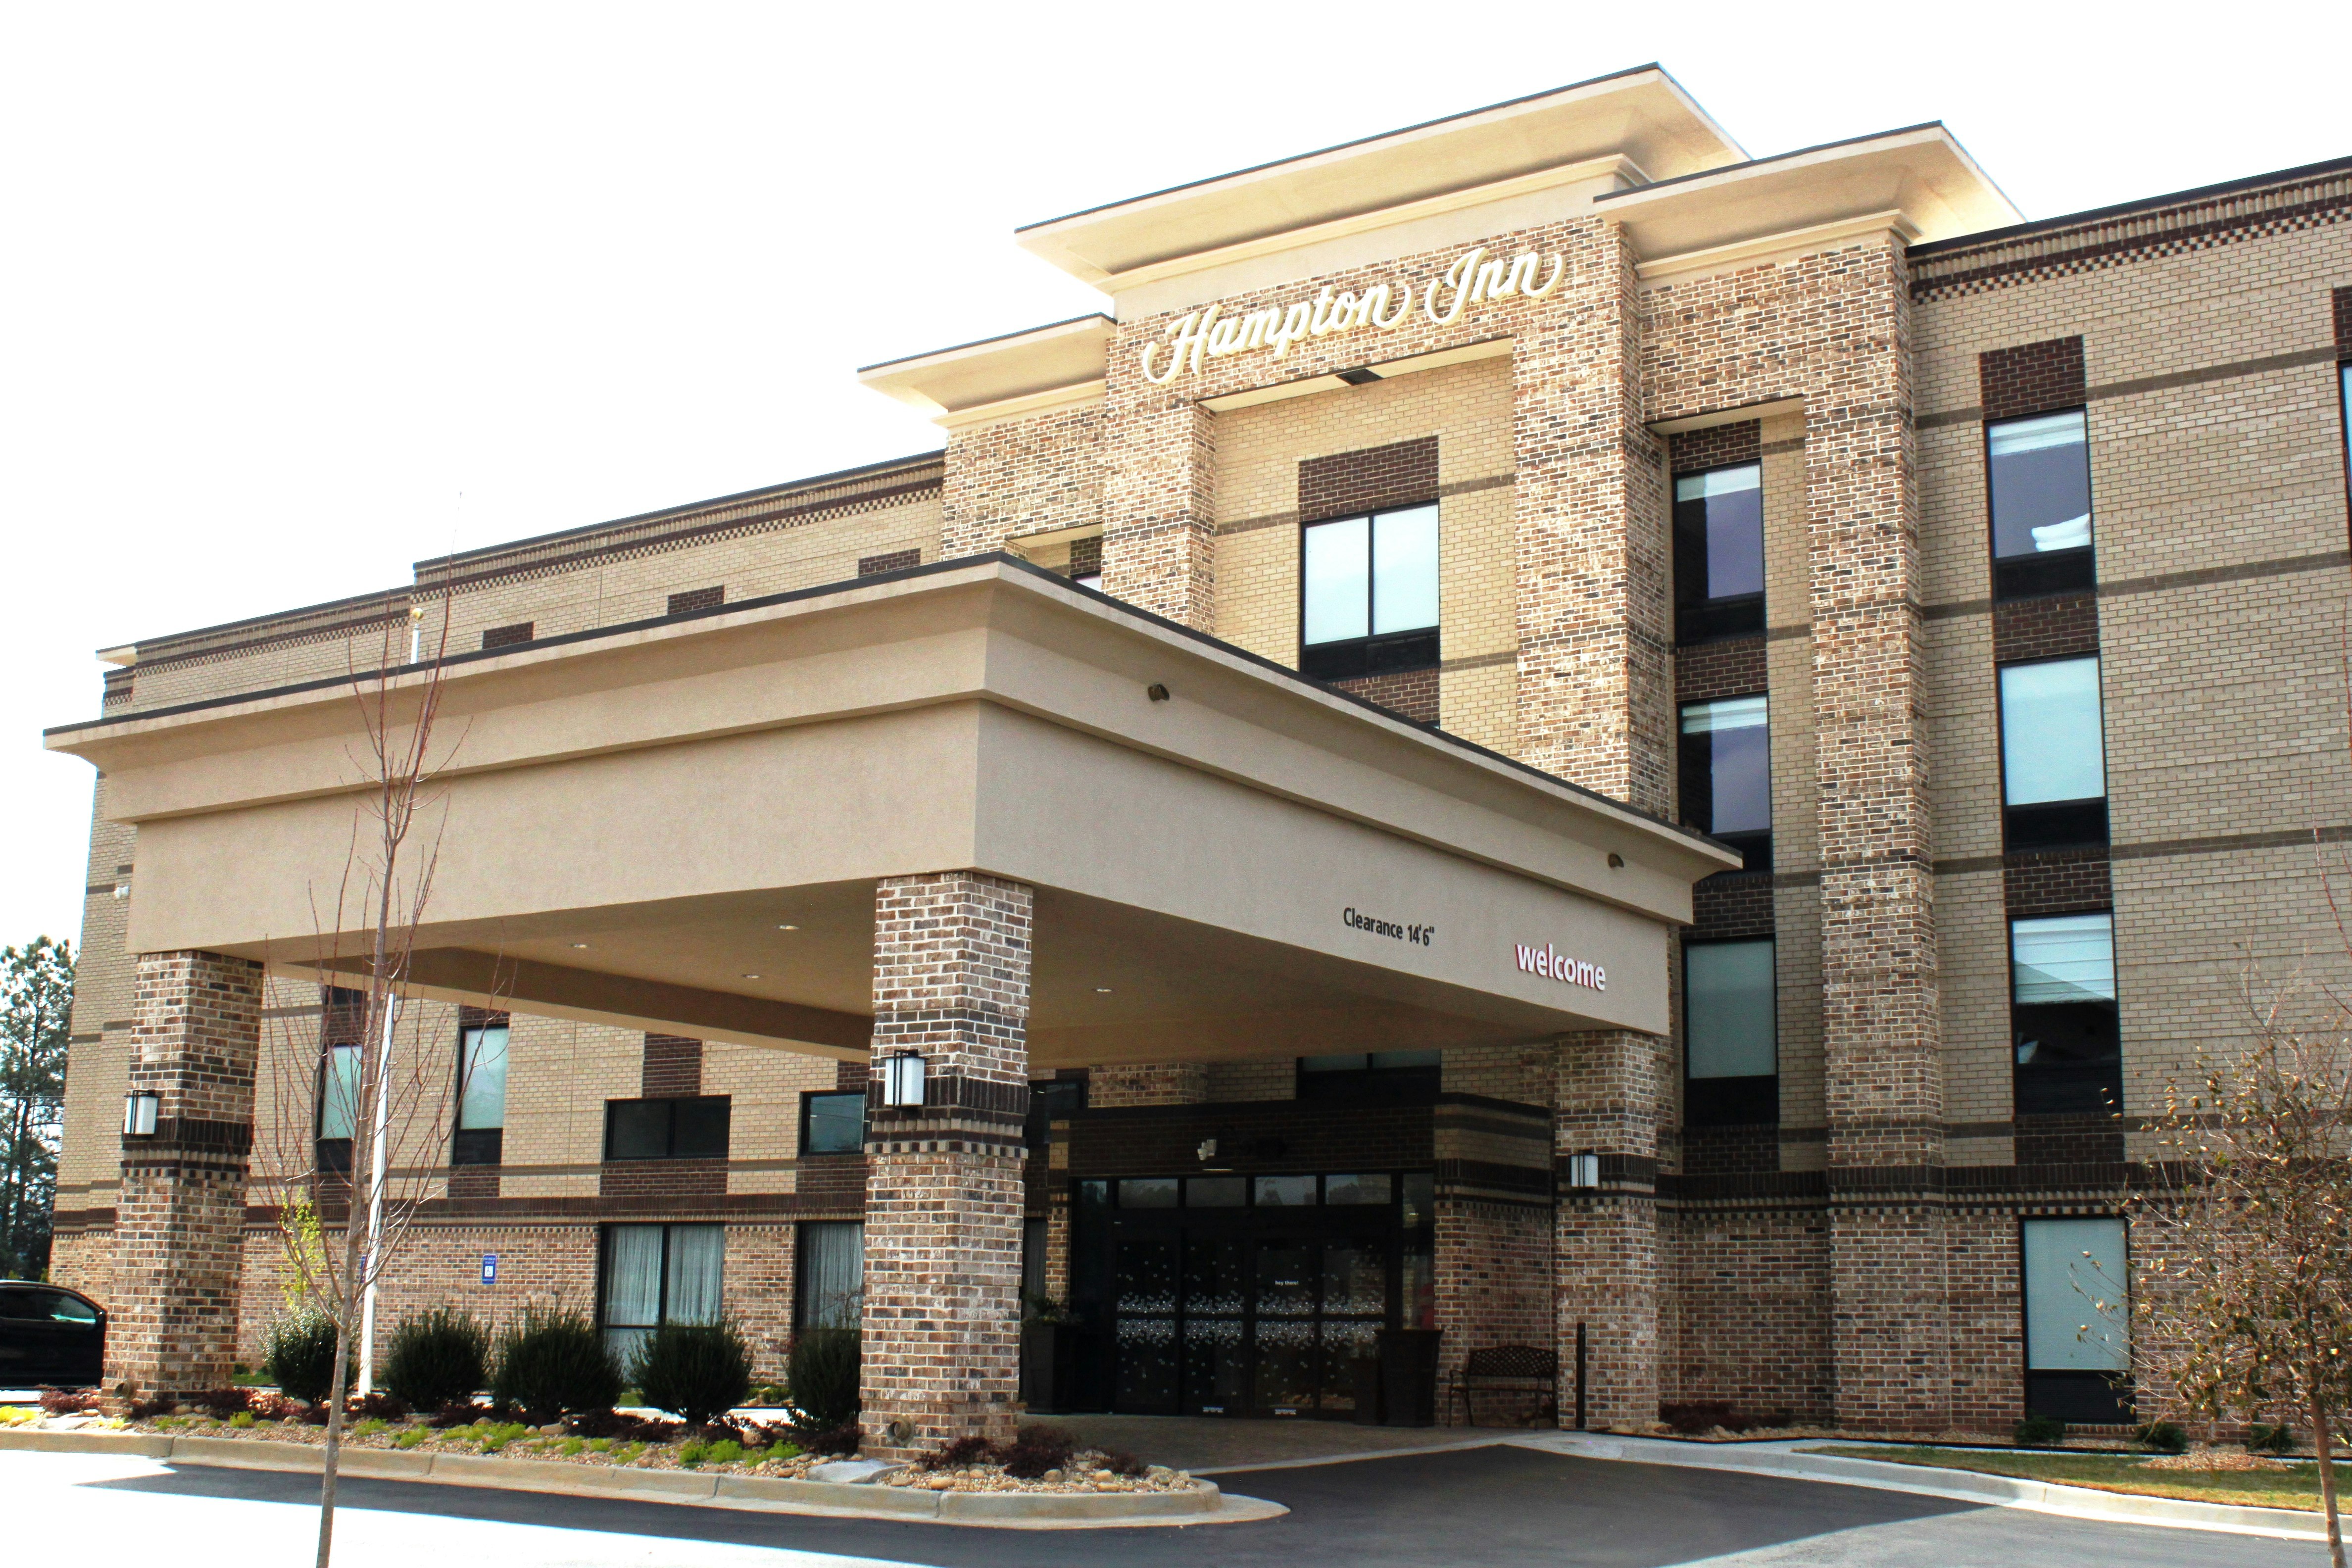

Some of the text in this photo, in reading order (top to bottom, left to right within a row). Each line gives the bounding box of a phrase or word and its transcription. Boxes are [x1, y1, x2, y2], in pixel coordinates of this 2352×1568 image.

[1141, 247, 1566, 385] Hampton Inn
[1343, 907, 1435, 947] Clearance 14'6"
[1515, 943, 1606, 990] welcome
